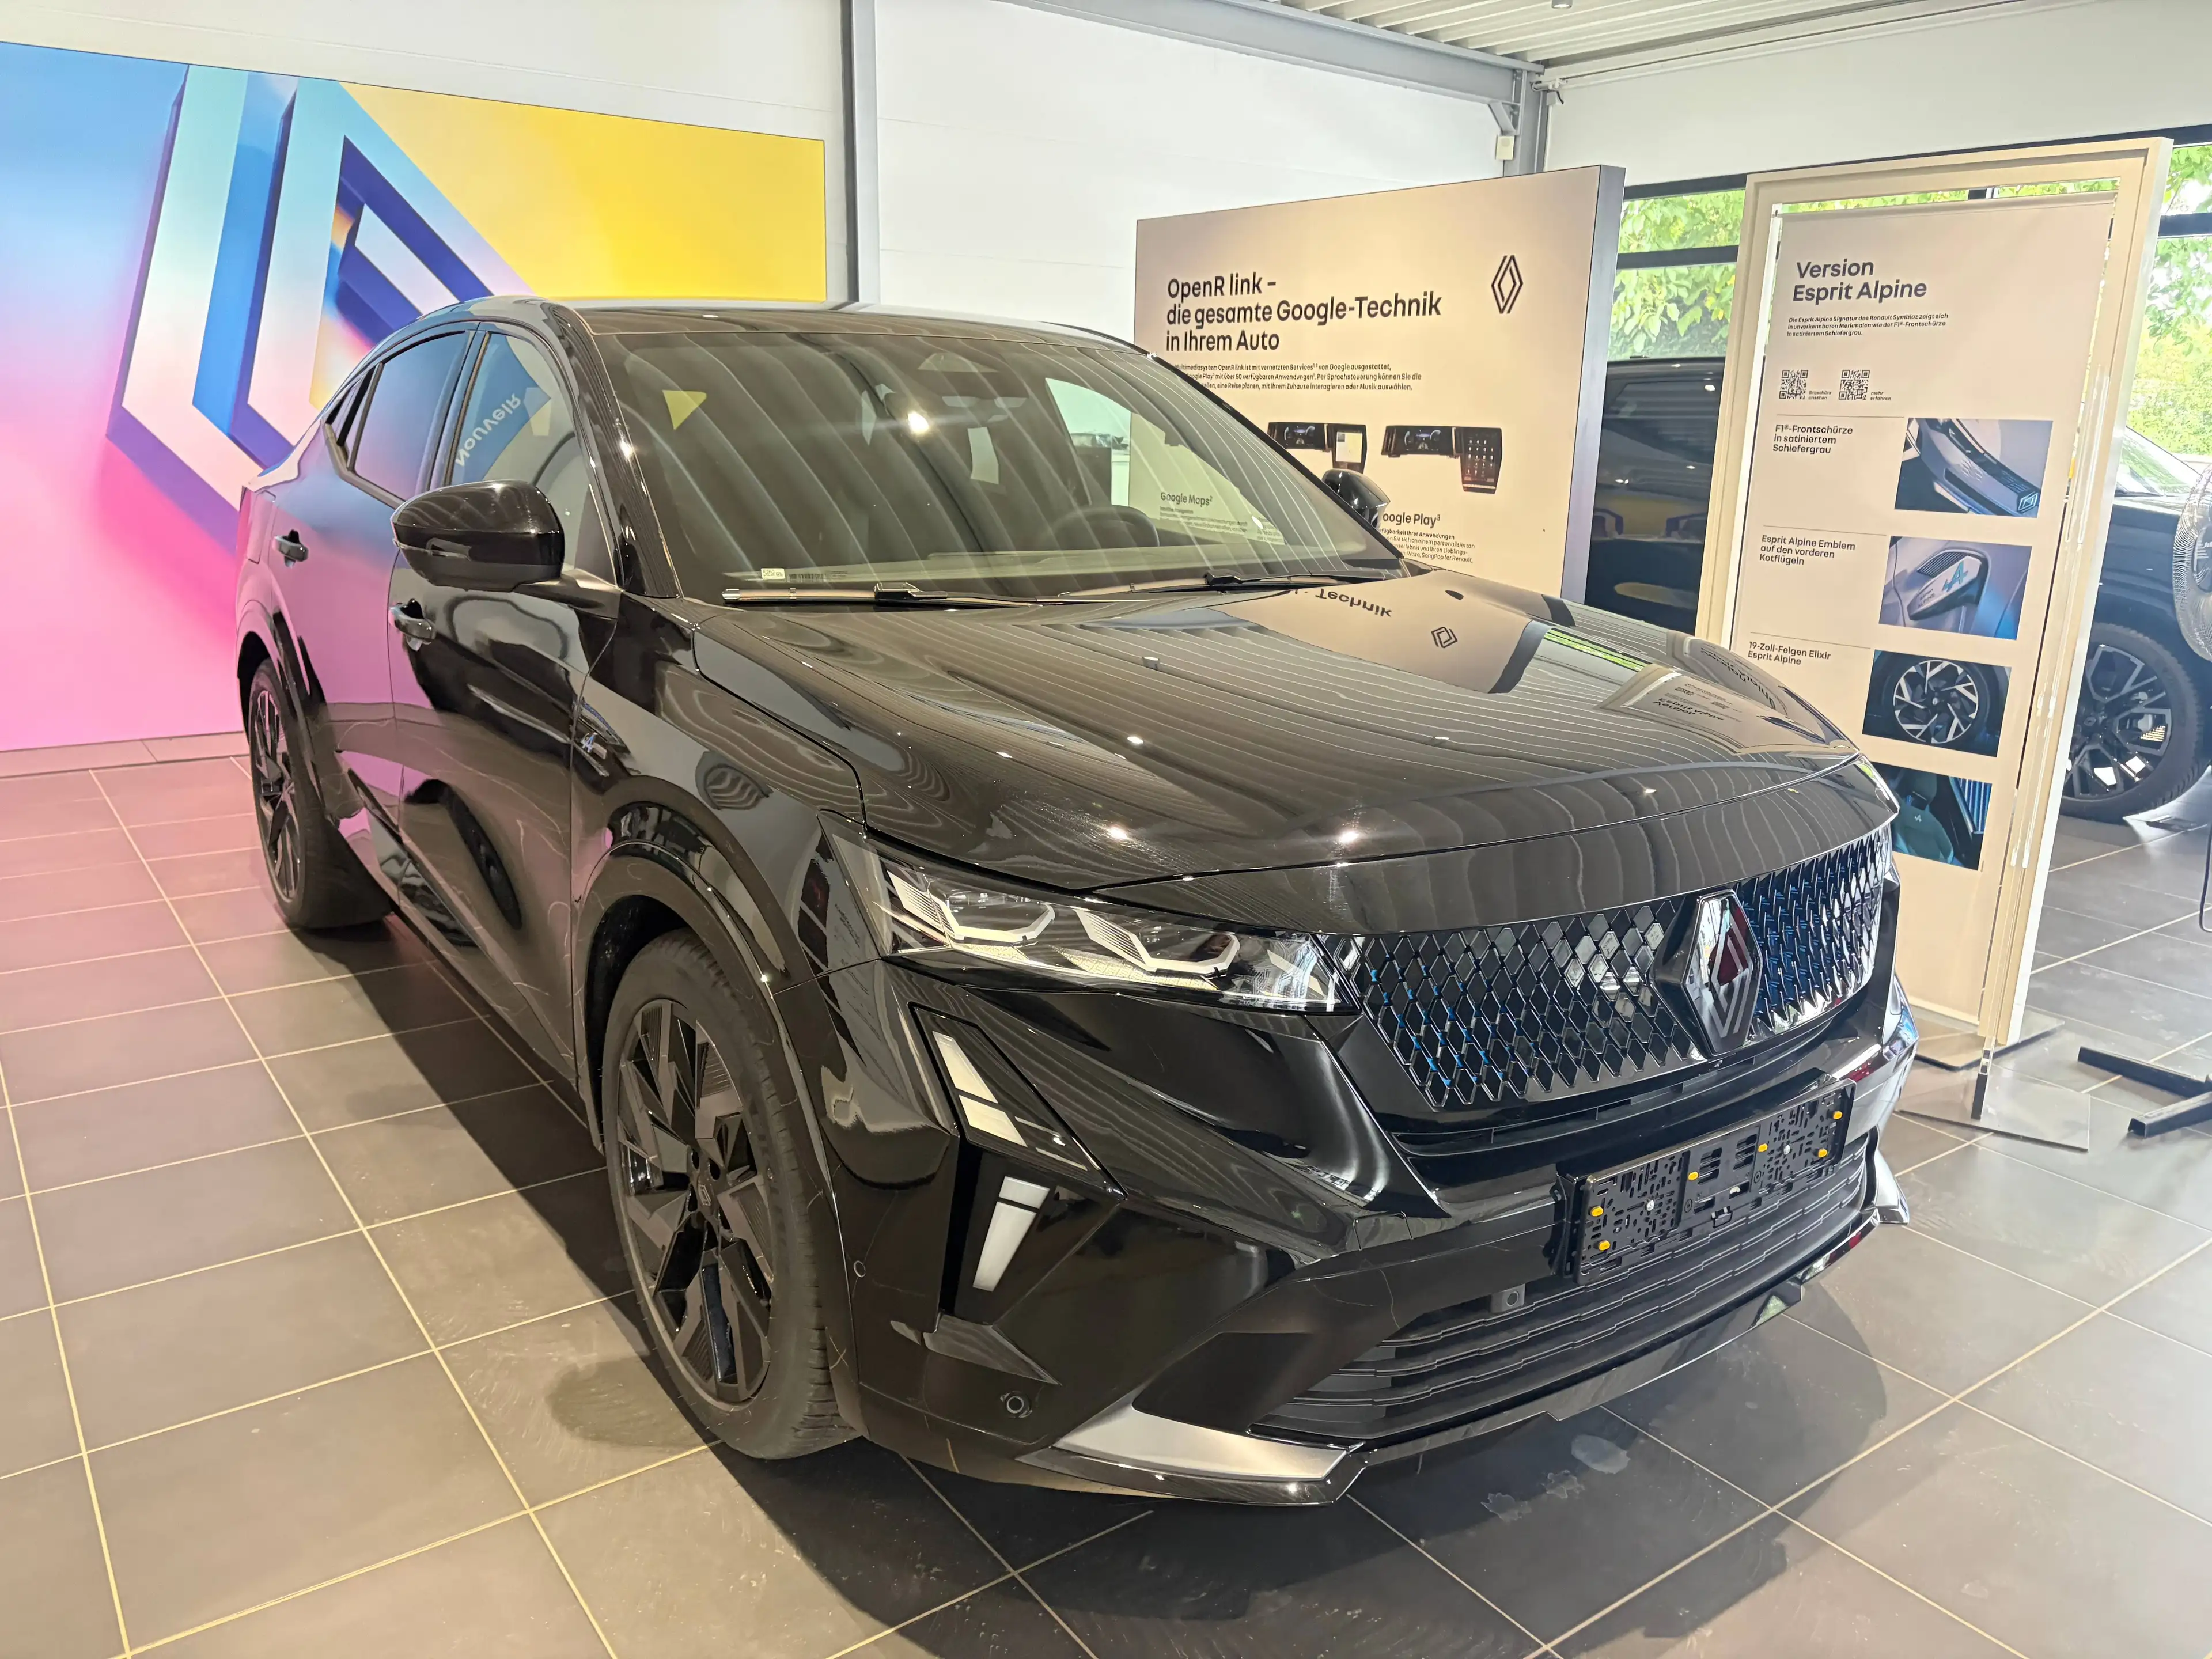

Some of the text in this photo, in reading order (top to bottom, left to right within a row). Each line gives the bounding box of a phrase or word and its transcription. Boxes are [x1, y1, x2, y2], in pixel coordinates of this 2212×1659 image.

[1796, 259, 1874, 279] Version
[1168, 275, 1225, 302] OpenR
[1229, 271, 1263, 296] link
[1793, 279, 1927, 305] Esprit Alpine
[1166, 290, 1442, 329] die gesamte Google-Technik
[1166, 330, 1280, 351] in Ihrem Auto
[1330, 363, 1350, 372] Google
[1243, 373, 1274, 381] verfügbaren
[1327, 373, 1377, 381] Sprachsteuerung
[1310, 382, 1344, 391] interagieren
[1774, 434, 1836, 444] in satiniertem
[1773, 444, 1831, 455] Schiefergrau
[1161, 492, 1188, 505] Google
[1382, 512, 1411, 525] oogle
[1419, 531, 1455, 540] Anwendungen
[1762, 535, 1855, 550] Esprit Alpine Emblem
[1777, 546, 1793, 554] den
[1795, 548, 1835, 558] vorderen
[1759, 554, 1804, 566] Kotflügeln
[1749, 641, 1831, 660] 19-Zoll-Felgen Elixir
[1748, 650, 1802, 665] Esprit Alpine
